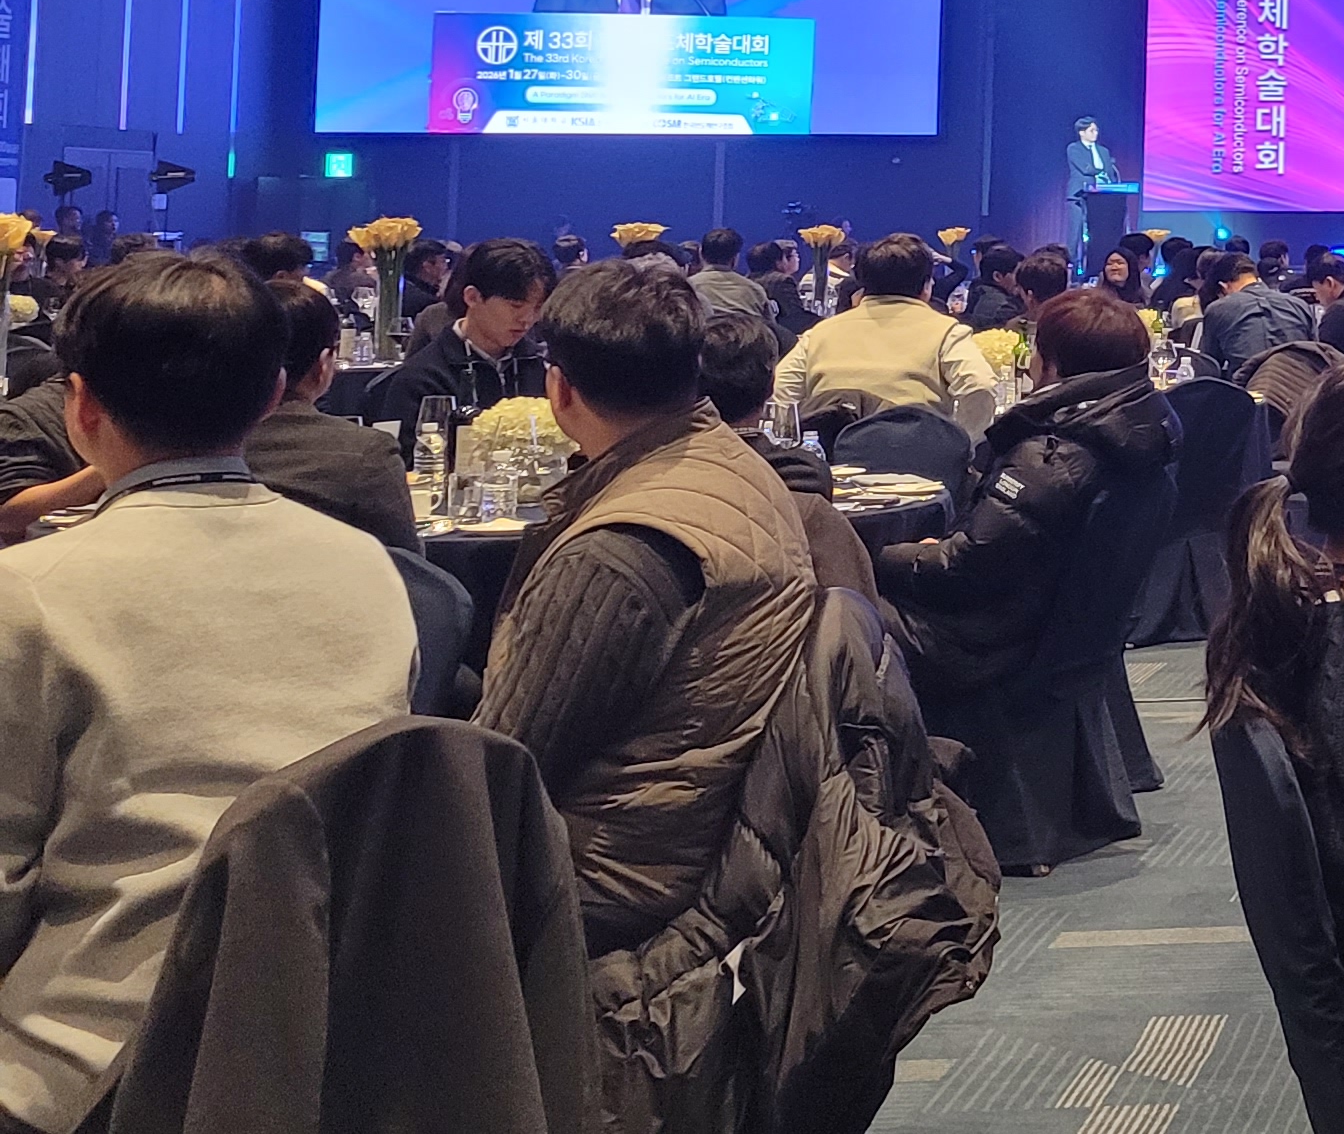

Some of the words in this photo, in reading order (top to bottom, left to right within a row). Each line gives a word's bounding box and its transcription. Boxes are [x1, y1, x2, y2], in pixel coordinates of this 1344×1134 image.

[523, 30, 544, 51] 제
[548, 30, 593, 51] 33회
[523, 53, 544, 63] The
[545, 53, 569, 64] 33rd
[687, 56, 769, 68] Semiconductors
[1236, 46, 1247, 63] on
[508, 69, 522, 81] 1월
[1213, 110, 1226, 126] for
[1232, 67, 1248, 173] Semiconductors
[1213, 133, 1224, 145] AI
[1211, 149, 1223, 173] Era
